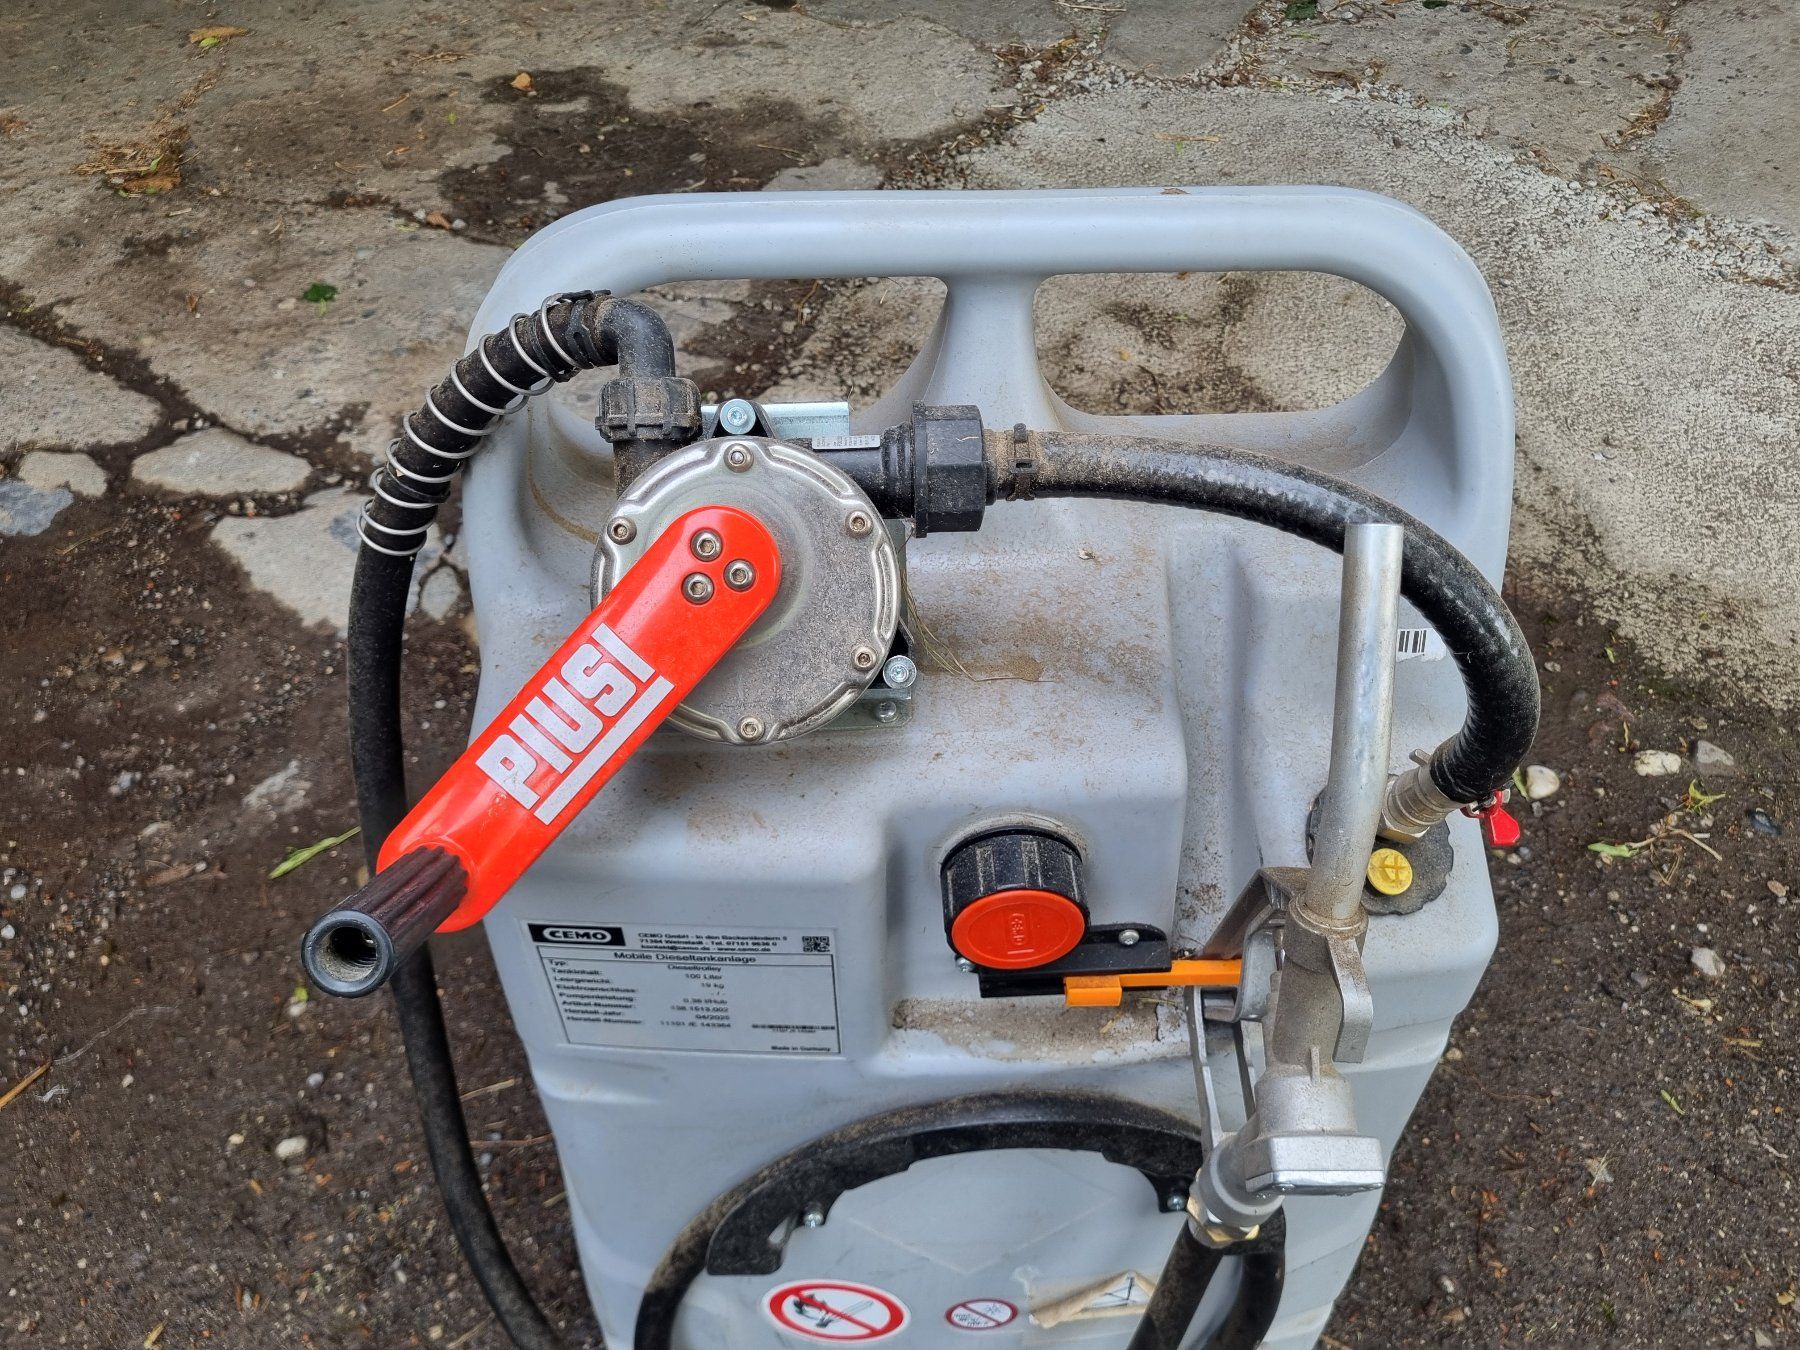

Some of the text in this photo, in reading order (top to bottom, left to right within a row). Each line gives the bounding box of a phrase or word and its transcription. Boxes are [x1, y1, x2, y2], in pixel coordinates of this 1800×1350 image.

[476, 623, 655, 810] PIUSI
[548, 930, 608, 940] CEMO
[613, 952, 756, 963] Mobile Dieseltankanlage
